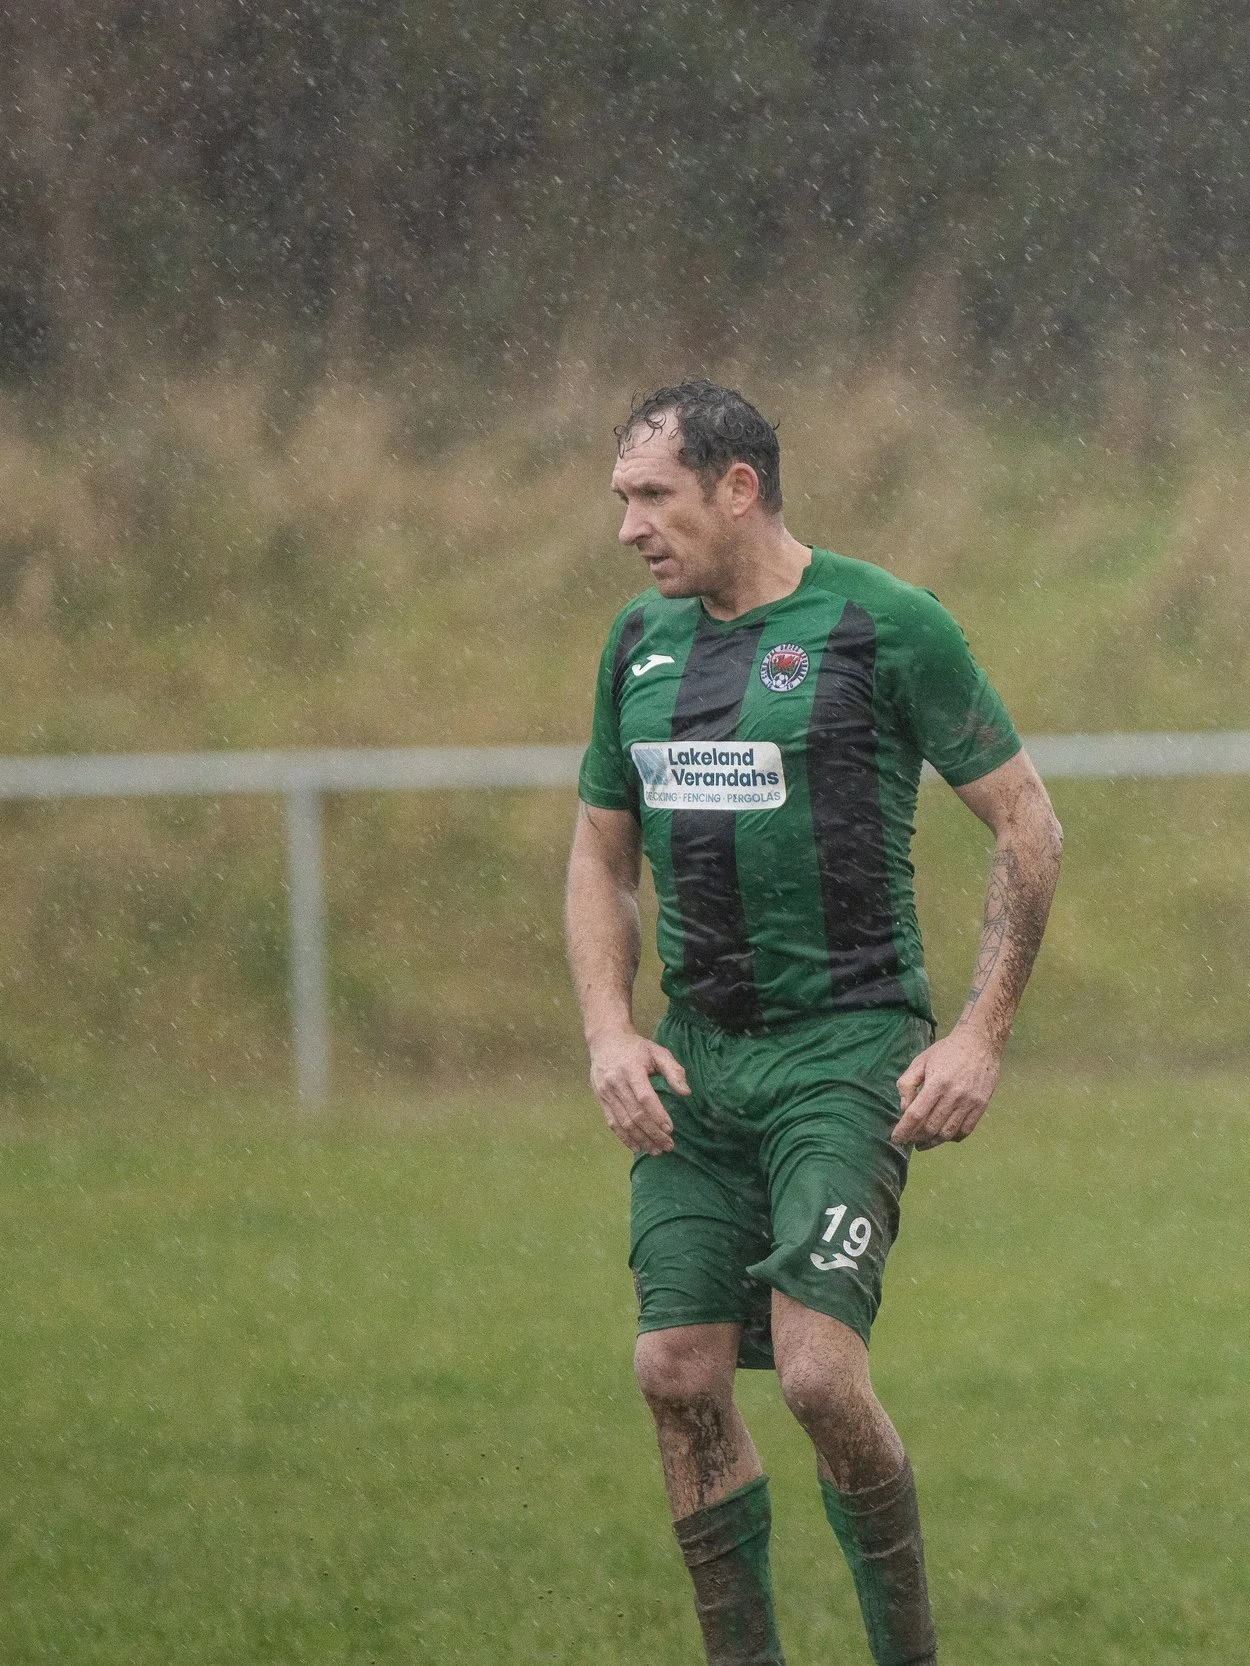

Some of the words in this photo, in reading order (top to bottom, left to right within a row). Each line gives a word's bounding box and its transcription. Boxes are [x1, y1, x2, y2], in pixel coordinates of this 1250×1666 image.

[668, 748, 754, 766] Lakeland
[671, 769, 779, 787] Verandahs
[683, 793, 721, 803] FENCING
[727, 792, 781, 803] PERGOLAS
[822, 1204, 872, 1257] 19
